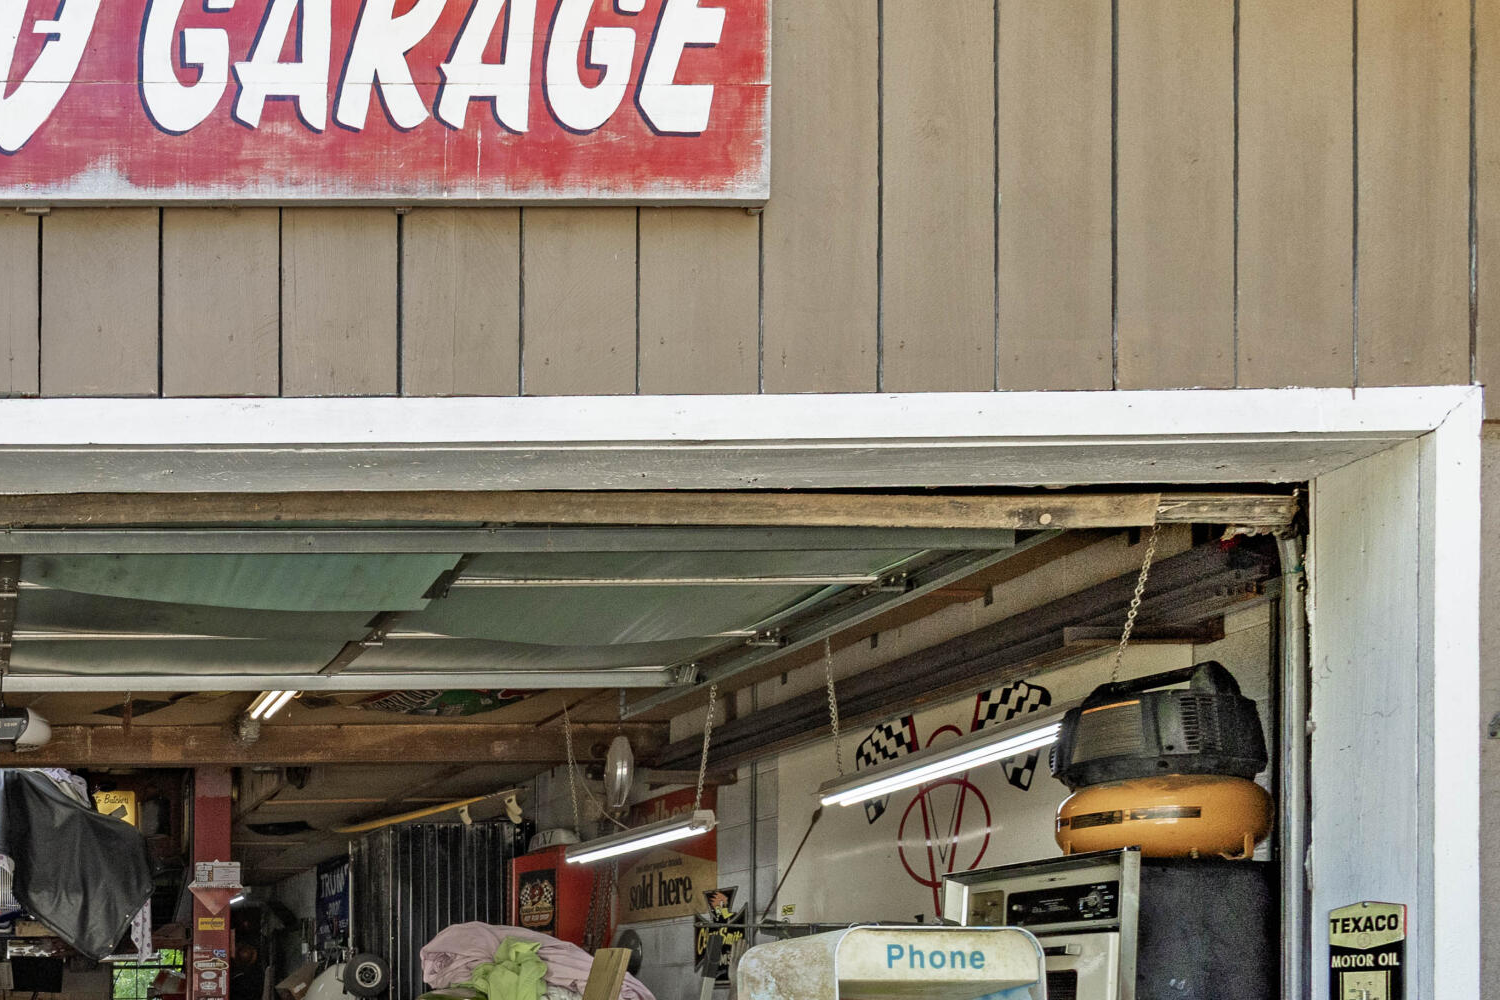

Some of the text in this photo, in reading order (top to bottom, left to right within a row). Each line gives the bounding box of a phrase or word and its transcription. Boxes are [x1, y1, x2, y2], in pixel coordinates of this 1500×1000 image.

[139, 0, 727, 137] GARAGE
[629, 871, 693, 912] sold here
[1330, 913, 1398, 934] TEXACO
[886, 943, 986, 970] Phone
[1331, 952, 1399, 968] MOTOR OIL
